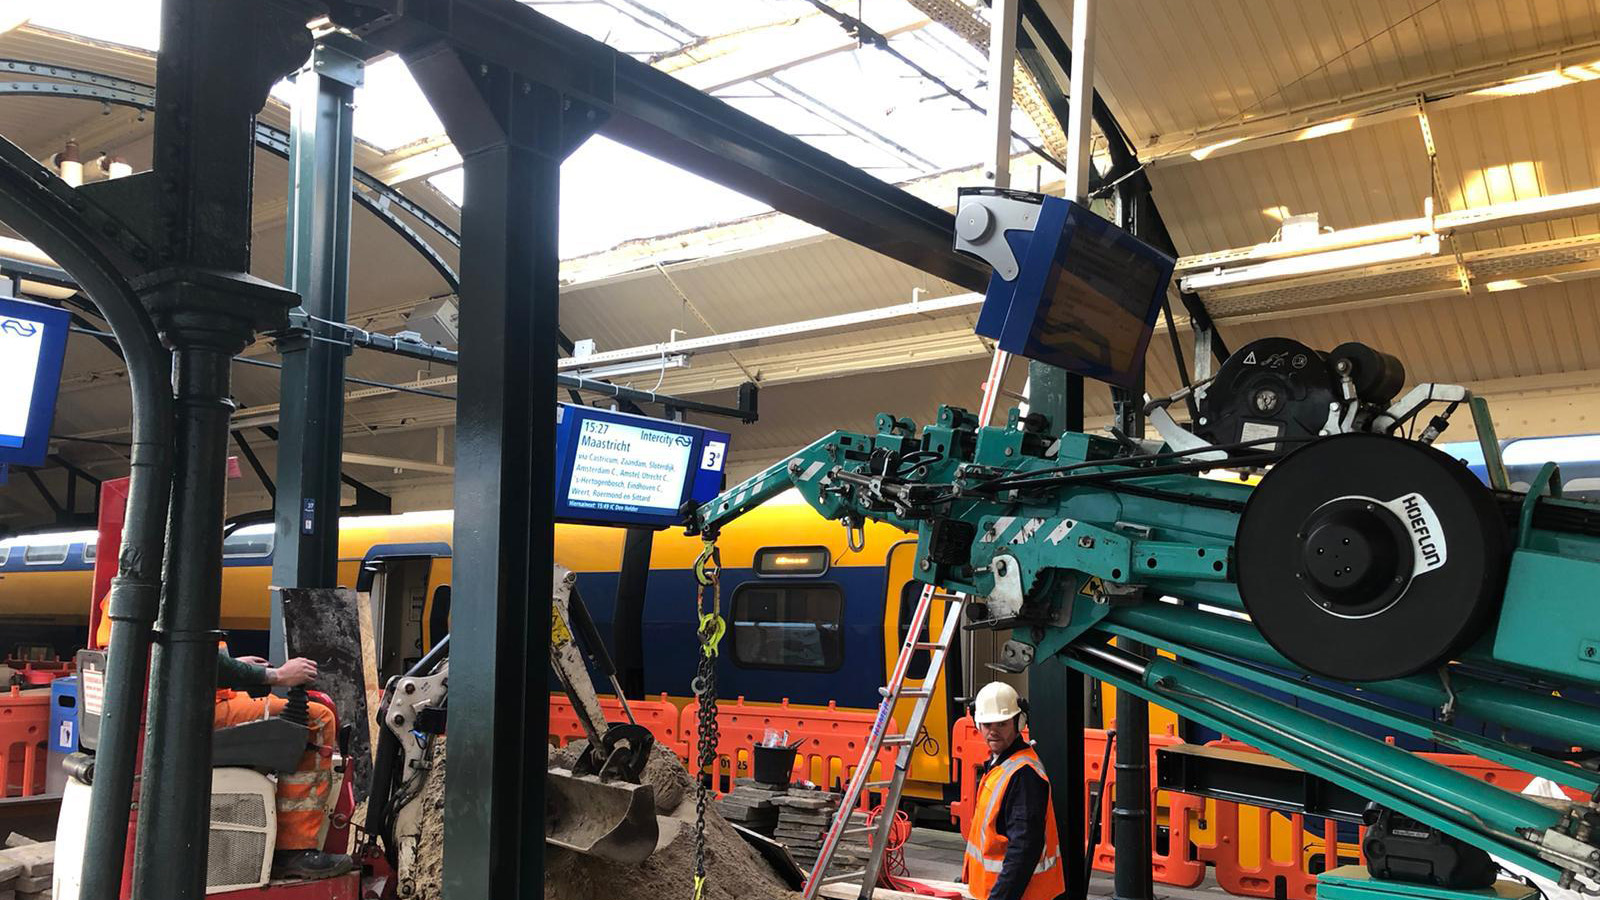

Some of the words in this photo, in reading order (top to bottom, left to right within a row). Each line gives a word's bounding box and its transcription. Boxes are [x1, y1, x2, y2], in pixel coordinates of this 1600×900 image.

[584, 421, 609, 435] 15:27
[640, 430, 674, 447] Intercity
[581, 435, 631, 453] Maastricht
[589, 453, 619, 465] Castricum,
[621, 457, 647, 468] Zaandam,
[576, 464, 610, 475] Amsterdam
[620, 468, 640, 479] Amstel,
[641, 472, 662, 481] Utrecht
[571, 487, 591, 497] Weert,
[592, 489, 623, 500] Roermond
[631, 492, 651, 502] Sittard
[627, 481, 656, 492] Eindhoven
[1402, 495, 1441, 567] HOEFLON
